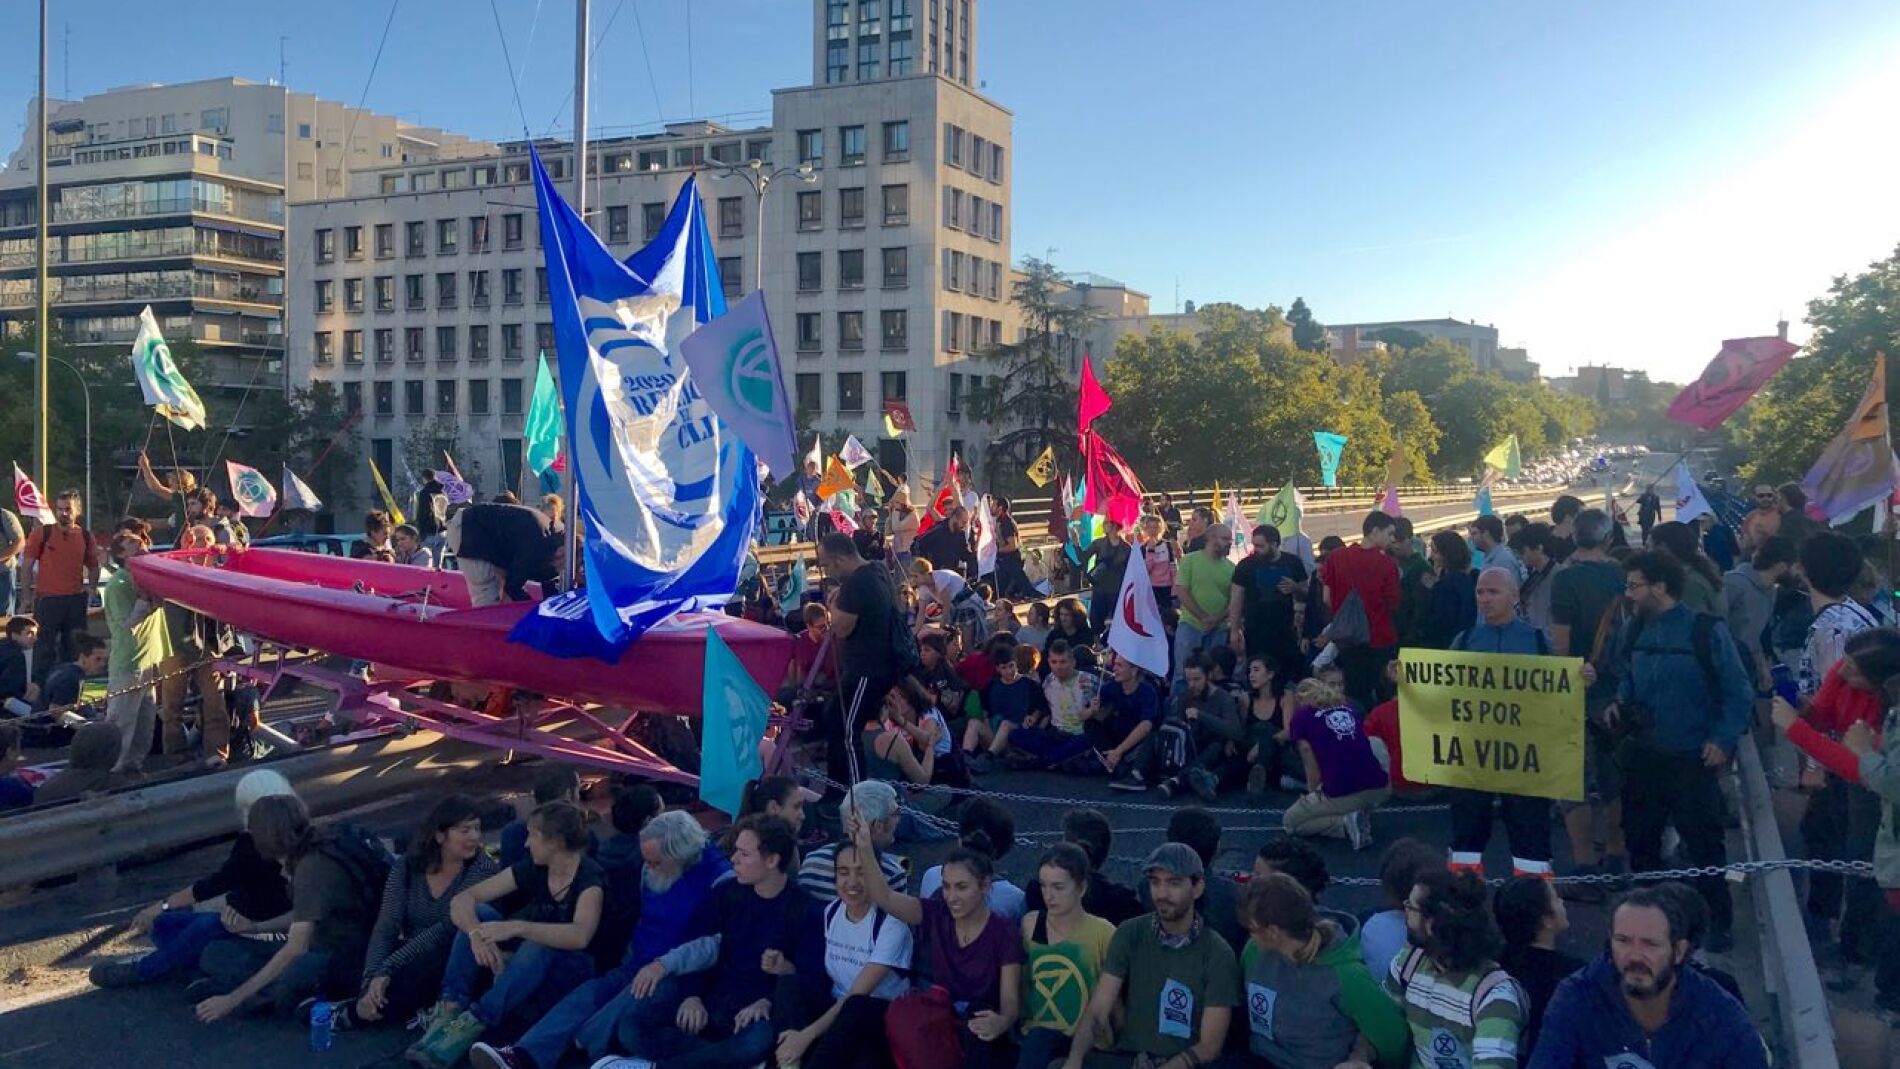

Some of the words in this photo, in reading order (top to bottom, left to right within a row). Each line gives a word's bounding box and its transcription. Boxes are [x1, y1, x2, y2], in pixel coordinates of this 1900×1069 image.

[1405, 662, 1496, 690] NUESTRA
[1503, 666, 1571, 693] LUCHA
[1452, 698, 1473, 722] ES
[1480, 701, 1521, 727] POR
[1433, 734, 1464, 766] LA
[1474, 738, 1540, 773] VIDA
